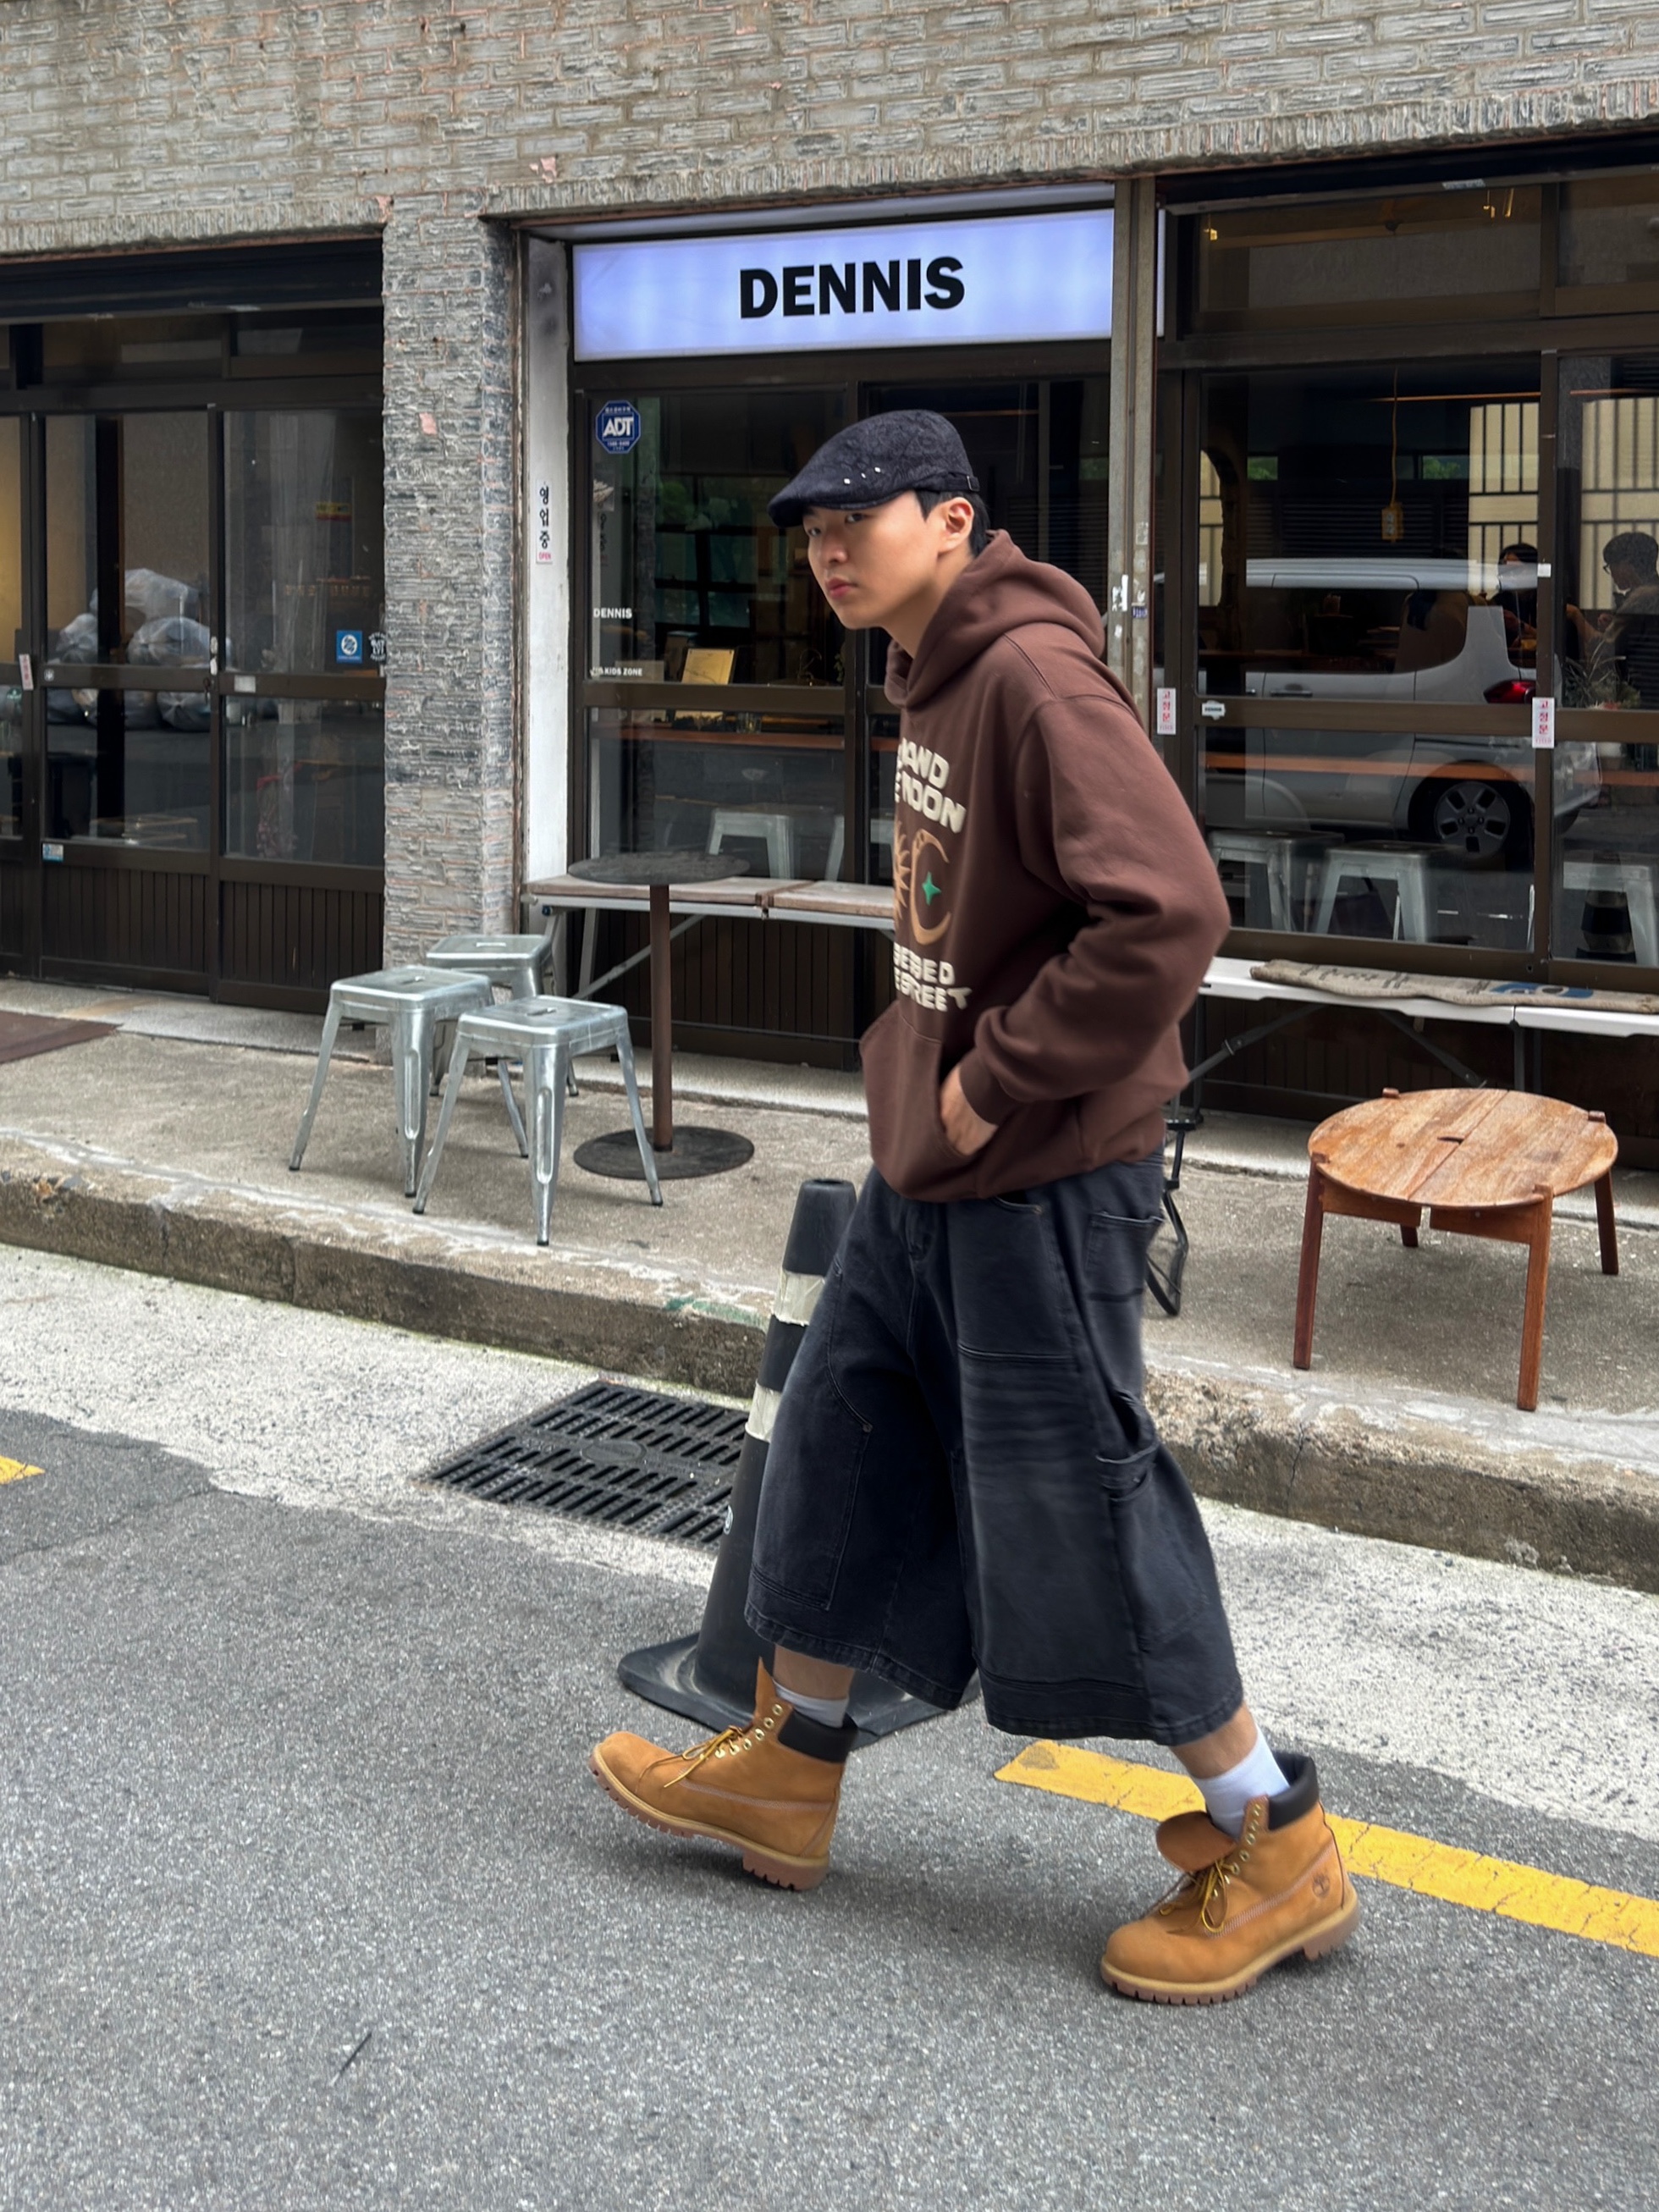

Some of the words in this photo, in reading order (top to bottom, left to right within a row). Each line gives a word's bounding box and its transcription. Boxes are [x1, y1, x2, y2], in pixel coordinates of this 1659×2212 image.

[740, 257, 965, 319] DENNIS
[603, 416, 634, 437] ADT
[539, 485, 550, 549] 영업중
[538, 552, 552, 560] OPEN
[593, 607, 632, 619] DENNIS
[623, 667, 642, 676] ZONE
